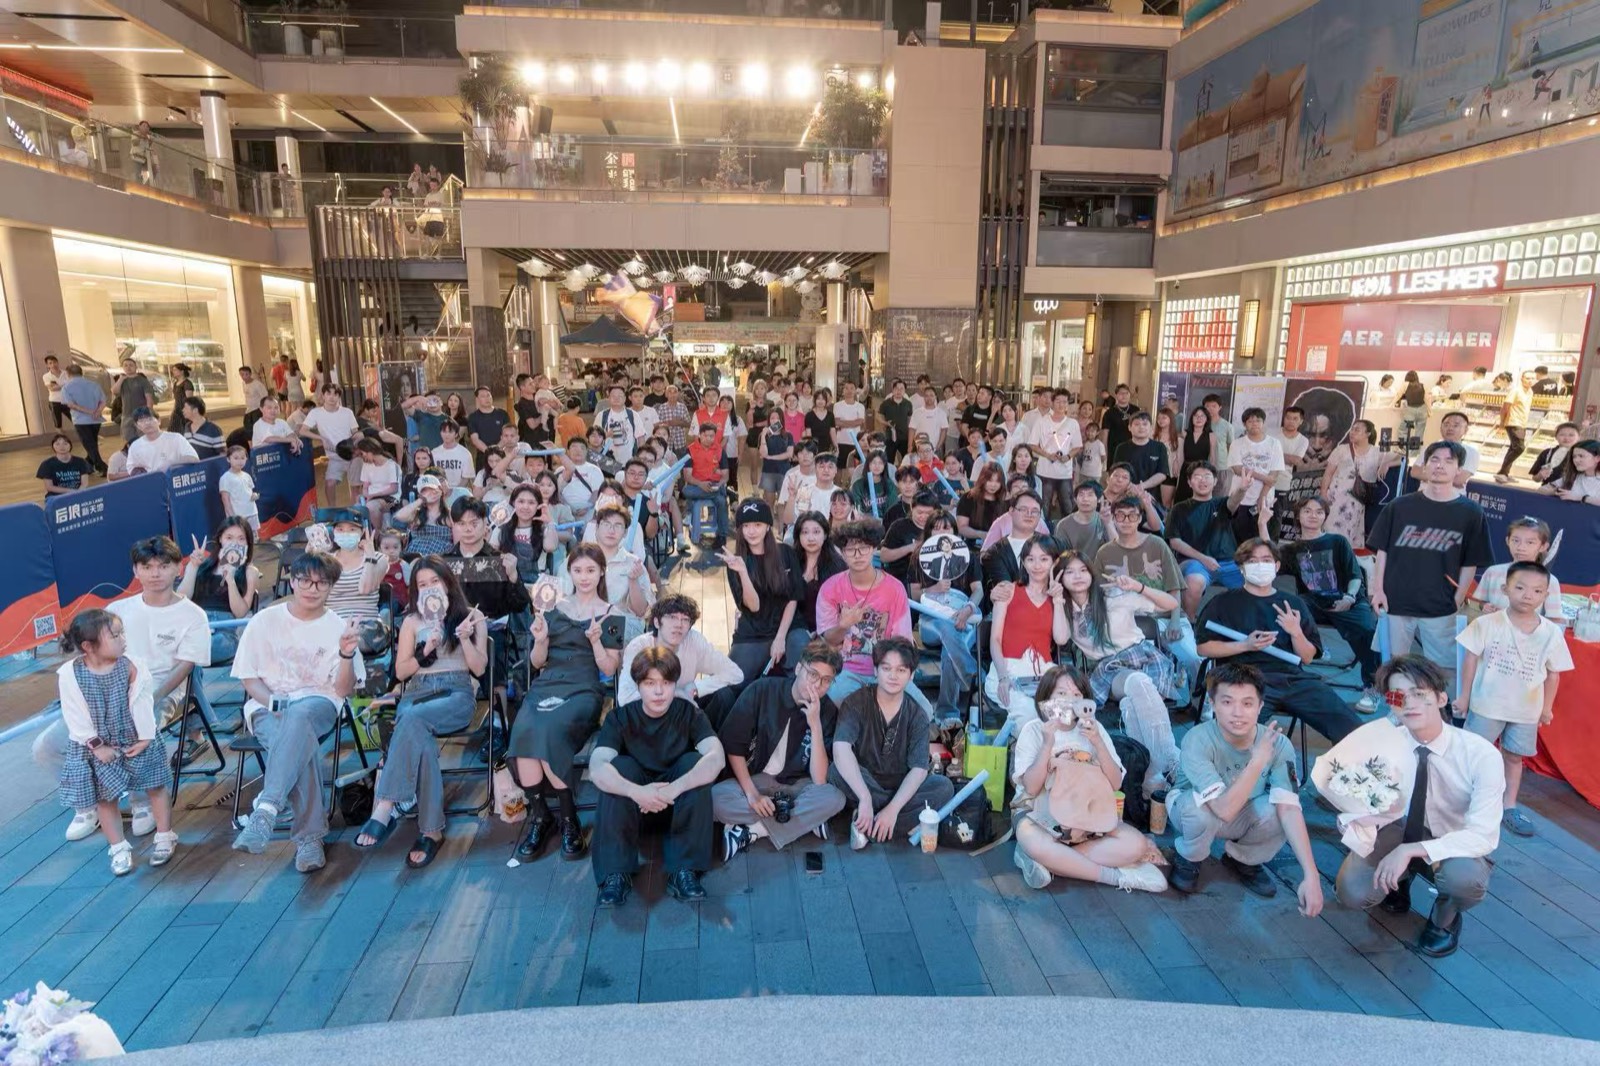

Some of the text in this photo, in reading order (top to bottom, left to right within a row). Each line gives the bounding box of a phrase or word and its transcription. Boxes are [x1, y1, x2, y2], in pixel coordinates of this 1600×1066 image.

[1397, 265, 1499, 293] LESHAER
[1340, 330, 1492, 347] AER LESHAER
[172, 473, 190, 488] 后浪
[56, 503, 104, 524] 后浪 新天地
